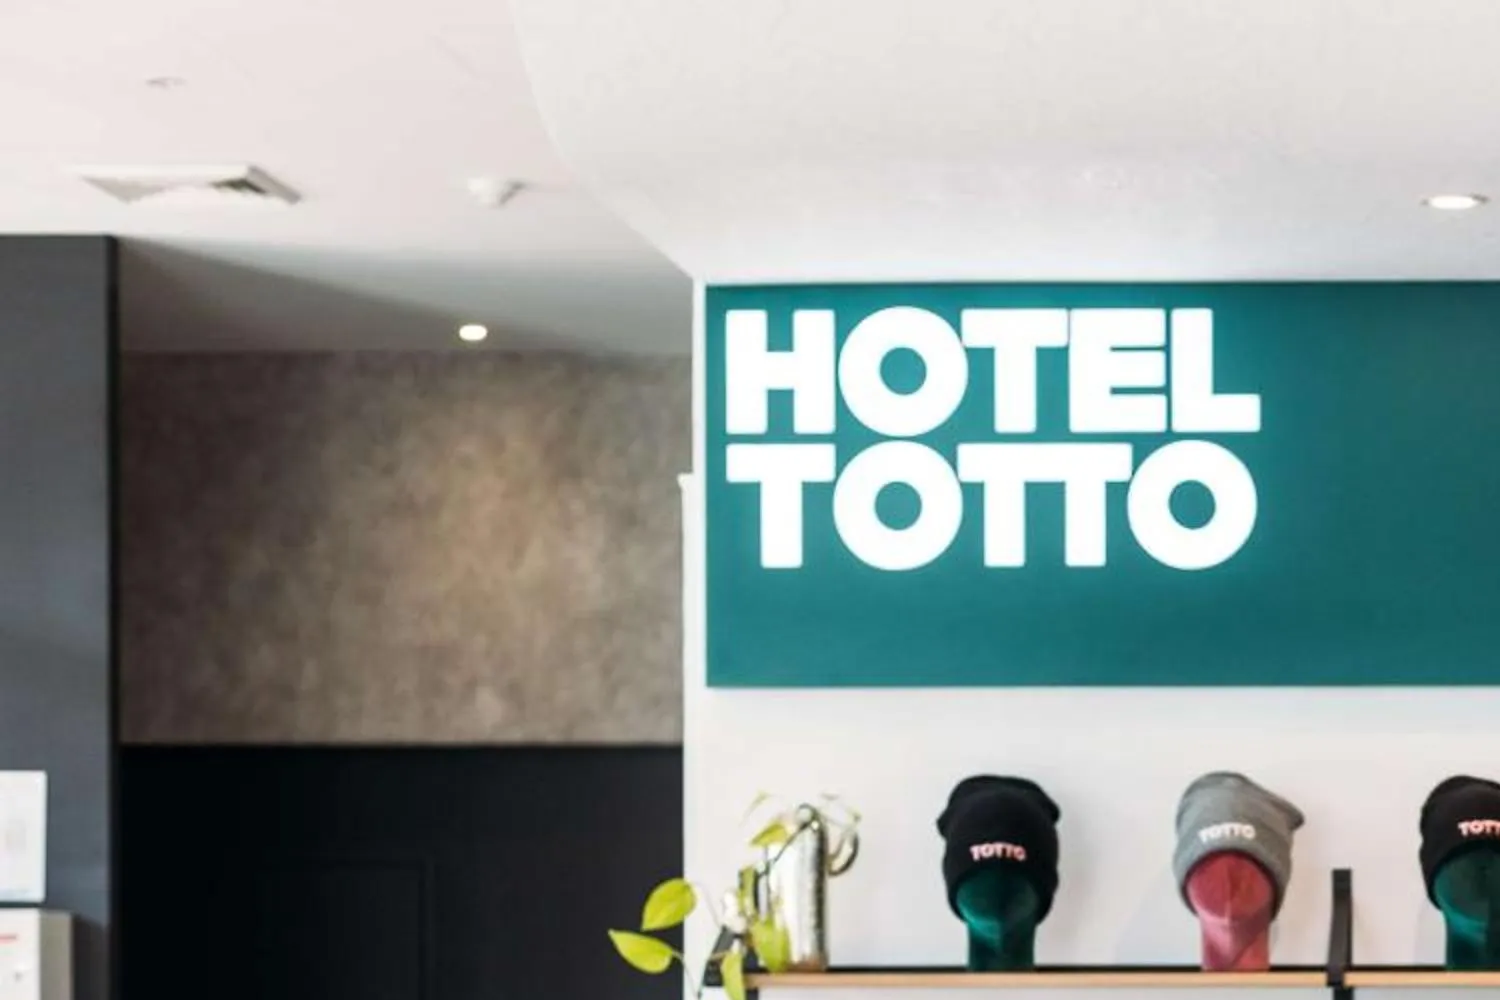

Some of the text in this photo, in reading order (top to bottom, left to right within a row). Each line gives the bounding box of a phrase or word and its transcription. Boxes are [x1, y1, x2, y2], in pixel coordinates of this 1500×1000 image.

[725, 305, 1262, 437] HOTEL
[725, 440, 1258, 571] TOTTO
[970, 841, 1026, 861] TOTTO
